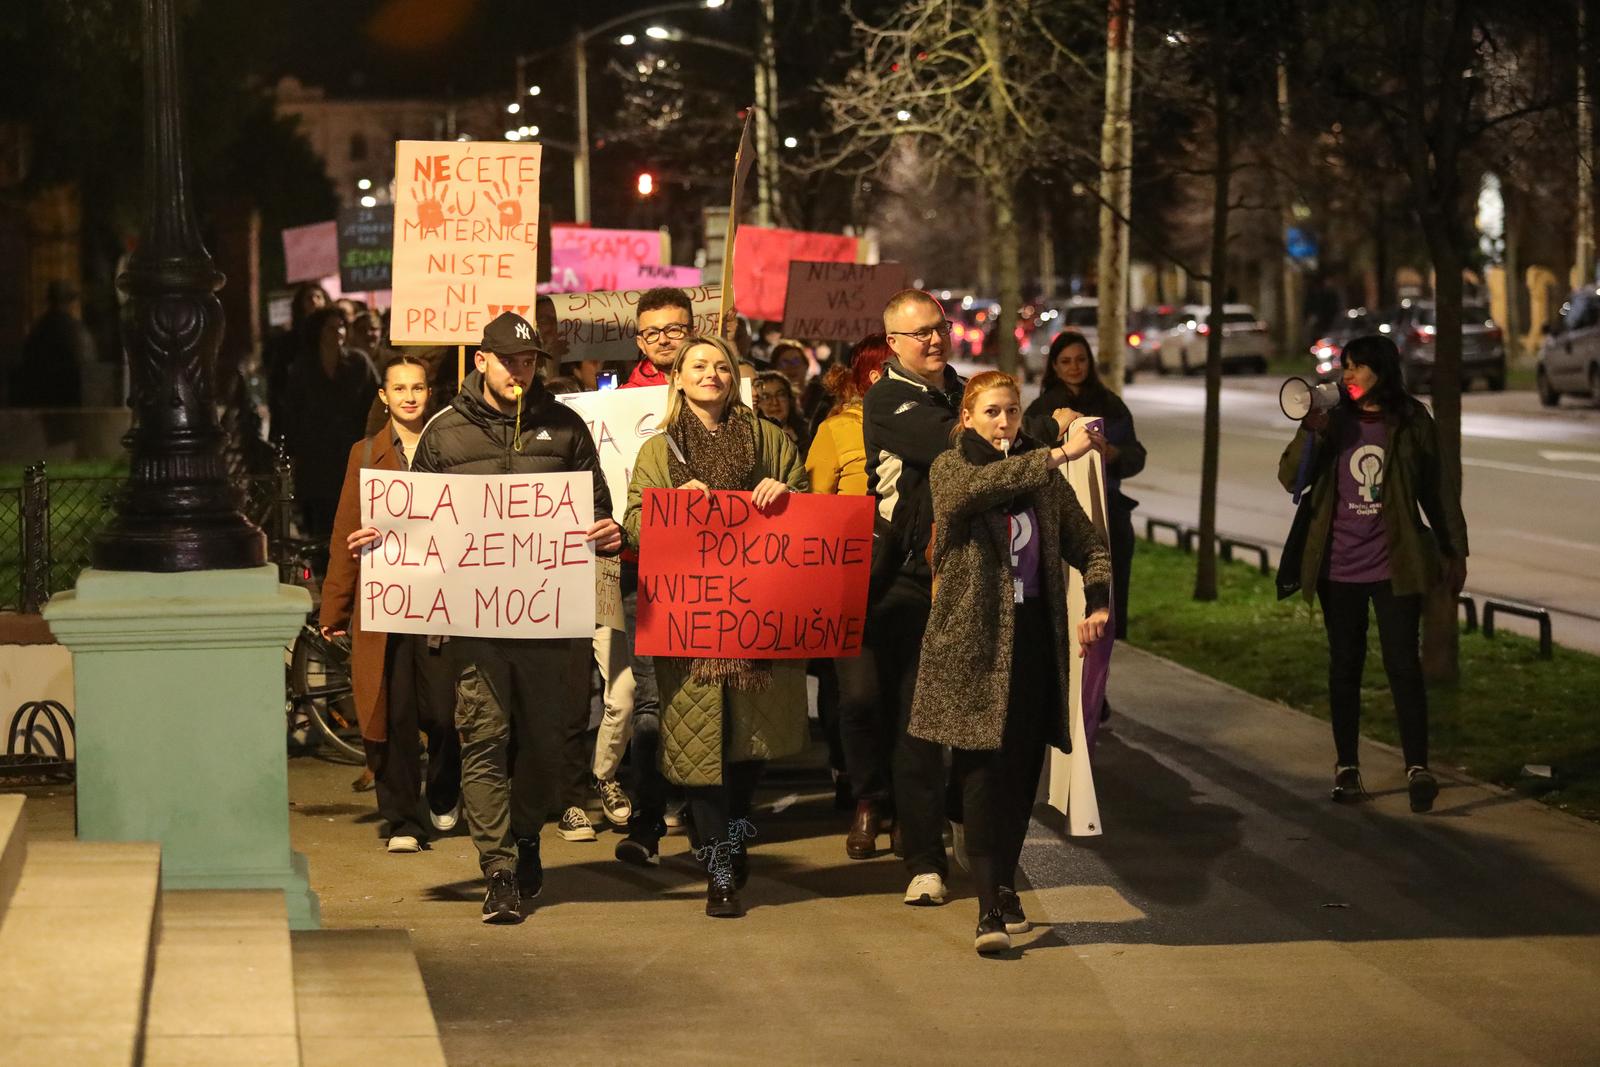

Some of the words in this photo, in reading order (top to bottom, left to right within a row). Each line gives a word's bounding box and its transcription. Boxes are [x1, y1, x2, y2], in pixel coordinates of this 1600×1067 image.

[456, 191, 475, 216] U
[428, 253, 515, 279] NISTE
[808, 263, 876, 282] NISAM
[446, 283, 477, 306] NI
[568, 290, 641, 311] SAMO
[827, 284, 866, 312] VAŠ
[365, 478, 458, 524] POLA
[483, 481, 579, 524] NEBA
[649, 492, 750, 528] NIKAD
[368, 526, 446, 573] POLA
[697, 531, 869, 568] POKORENE
[365, 581, 451, 624] POLA
[475, 578, 561, 629] MOĆI
[643, 574, 751, 605] UVIJEK
[668, 608, 861, 652] NEPOSLUŠNE
